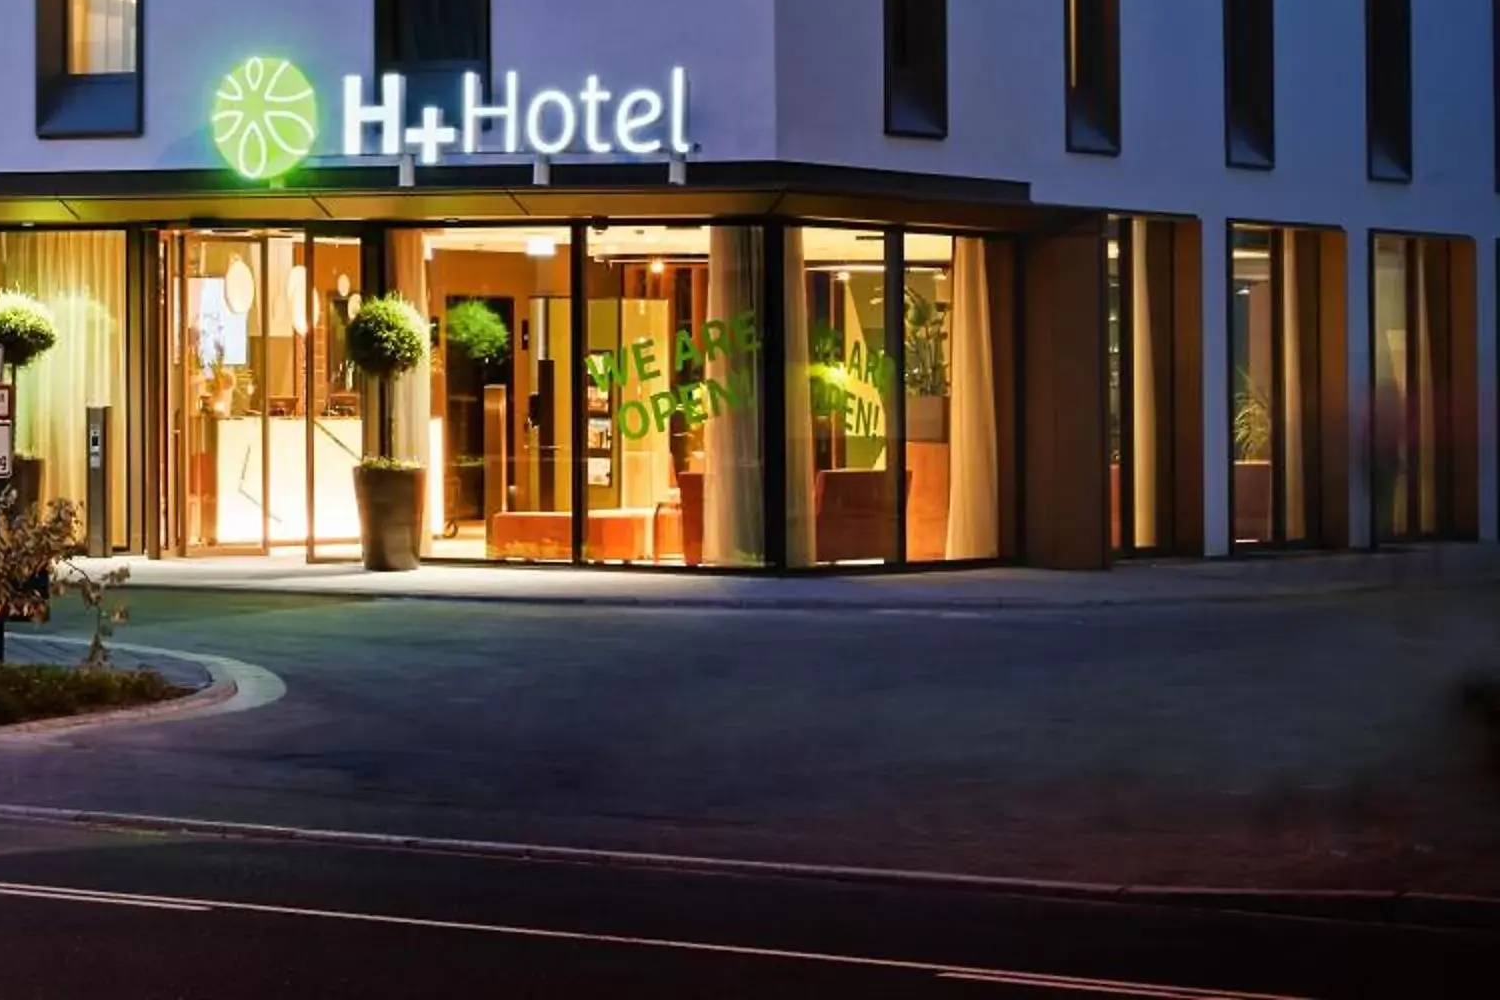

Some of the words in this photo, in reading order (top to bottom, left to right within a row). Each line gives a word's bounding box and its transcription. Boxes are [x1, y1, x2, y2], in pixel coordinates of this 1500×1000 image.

[342, 66, 690, 164] H+Hotel
[585, 338, 661, 393] WE
[675, 311, 761, 371] ARE
